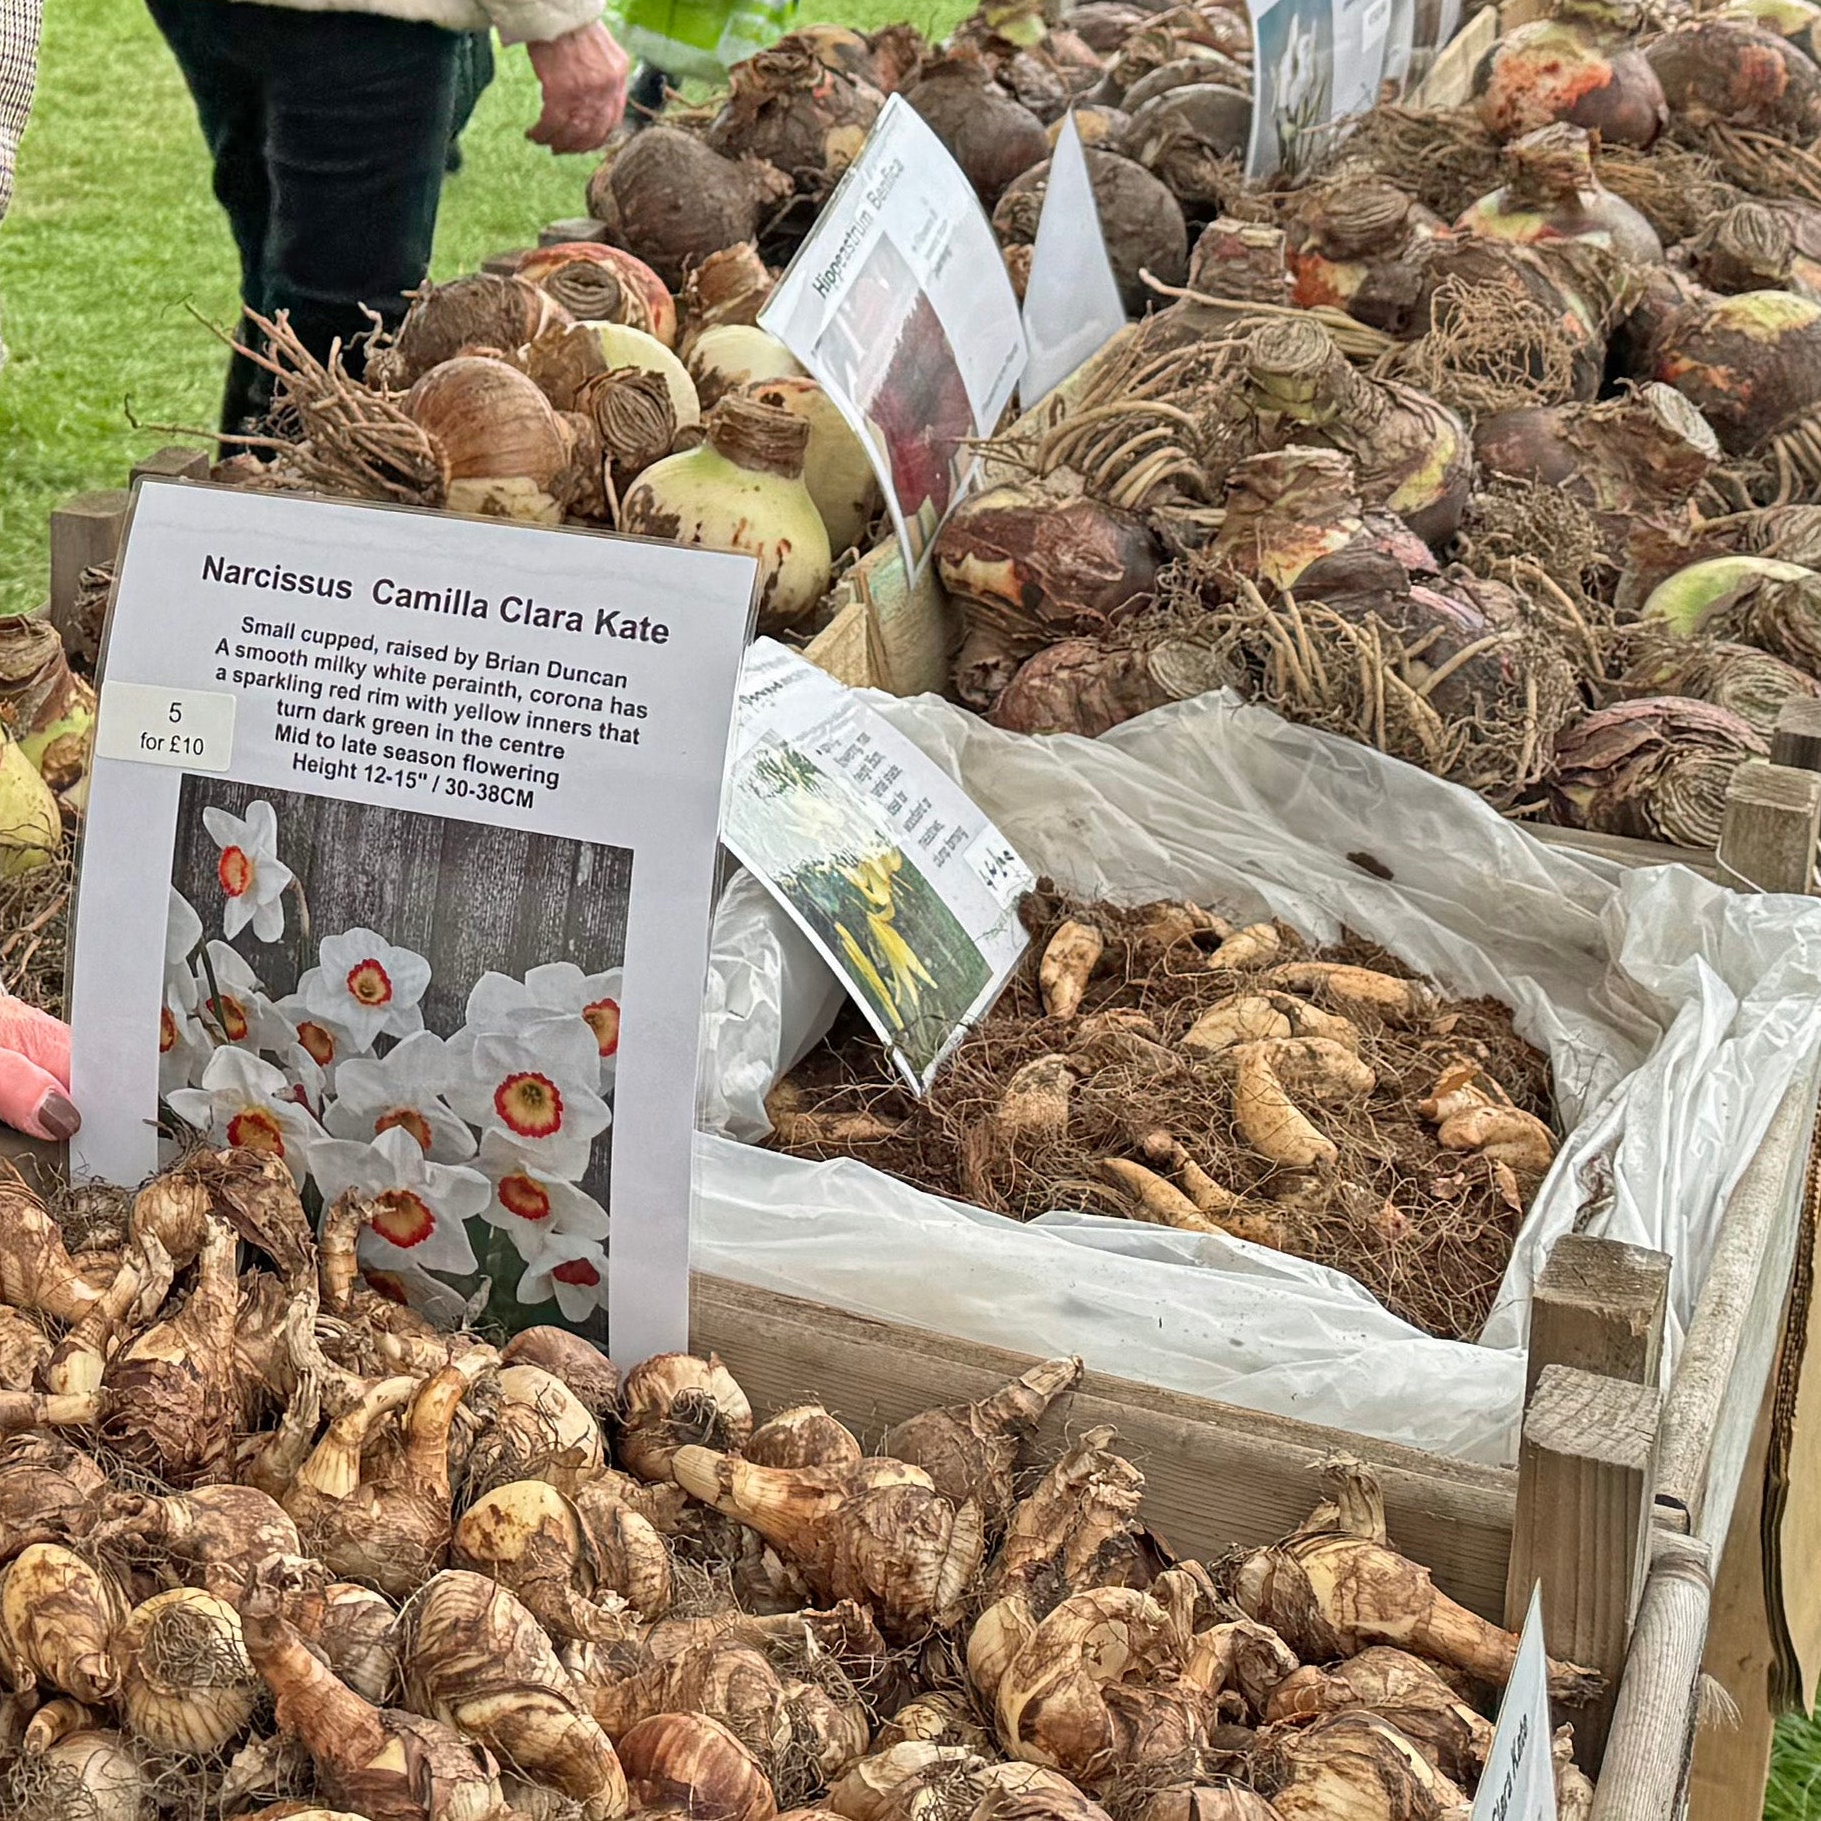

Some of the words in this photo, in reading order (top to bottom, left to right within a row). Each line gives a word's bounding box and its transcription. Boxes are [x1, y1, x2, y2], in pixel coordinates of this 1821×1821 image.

[201, 554, 353, 600] Narcissus
[372, 578, 489, 620] Camilla
[499, 595, 584, 633] Clara
[594, 608, 670, 645] Kate
[214, 637, 230, 657] A
[234, 644, 308, 668] smooth
[314, 654, 368, 681] milky
[372, 662, 427, 685] white
[431, 674, 523, 704] perainth,
[529, 688, 604, 712] corona
[610, 695, 648, 720] has
[241, 616, 296, 640] Small
[300, 628, 379, 656] cupped,
[385, 639, 449, 662] raised
[453, 646, 480, 671] by
[485, 650, 540, 676] Brian
[546, 660, 628, 690] Duncan
[168, 701, 183, 724] 5
[215, 667, 227, 682] a
[232, 669, 323, 700] sparkling
[328, 683, 362, 702] red
[366, 686, 400, 708] rim
[405, 694, 448, 715] with
[452, 702, 521, 726] yellow
[525, 710, 592, 738] inners
[598, 721, 641, 746] that
[276, 698, 317, 721] turn
[322, 705, 367, 729] dark
[371, 717, 430, 739] green
[435, 722, 454, 743] in
[460, 727, 494, 749] the
[499, 737, 565, 760] centre
[140, 731, 166, 751] for
[169, 734, 204, 756] £10
[274, 722, 311, 746] Mid
[315, 730, 336, 750] to
[341, 733, 378, 757] late
[382, 745, 456, 770] season
[462, 753, 560, 791] flowering
[292, 751, 358, 781] Height
[363, 763, 428, 790] 12-15"
[431, 774, 441, 794] /
[444, 777, 534, 809] 30-38CM
[1510, 1713, 1528, 1780] Kate
